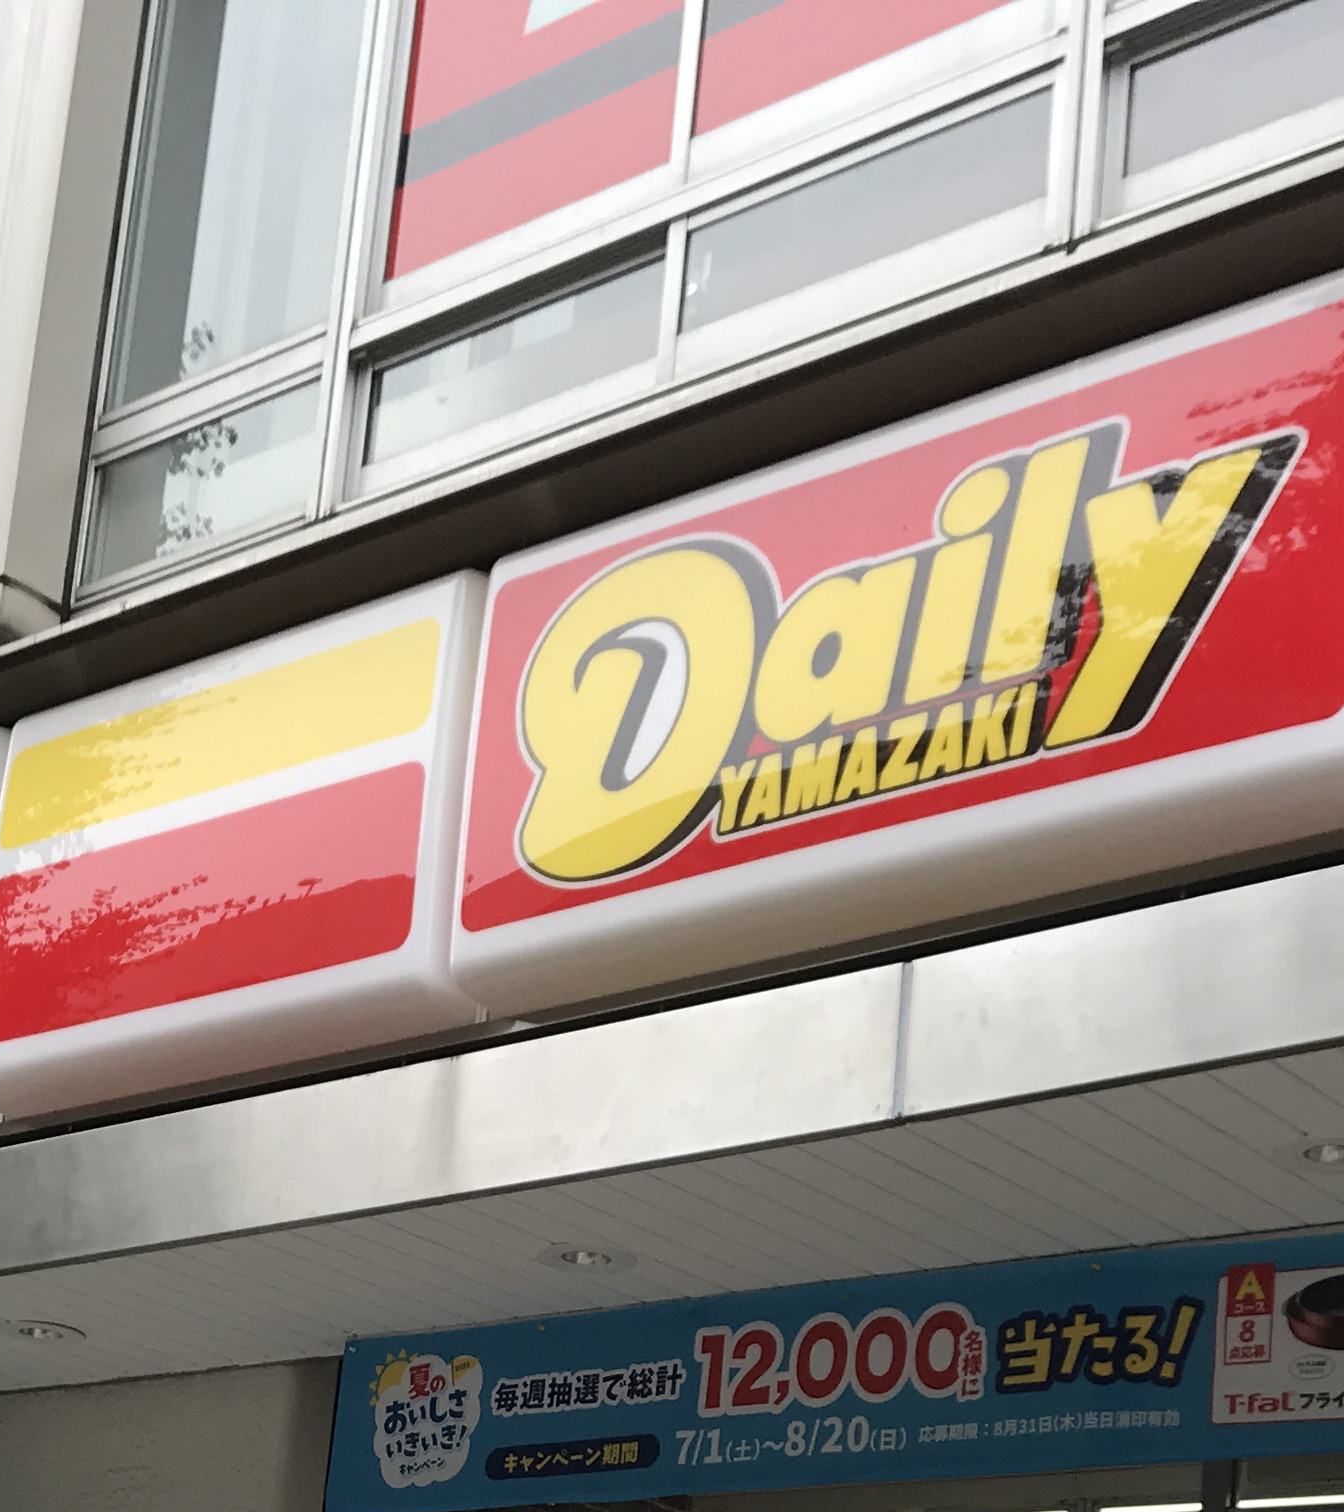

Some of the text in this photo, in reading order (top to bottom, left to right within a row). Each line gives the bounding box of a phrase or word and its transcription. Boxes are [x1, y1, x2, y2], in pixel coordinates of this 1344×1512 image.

[518, 425, 1301, 882] Daily
[717, 682, 1043, 835] YAMAZAKI
[1235, 1270, 1266, 1301] A
[1233, 1301, 1267, 1314] コース
[1002, 1303, 1201, 1387] 当たる!
[1239, 1320, 1256, 1343] 8
[700, 1308, 968, 1411] 12,000
[408, 1362, 447, 1400] 夏の
[494, 1363, 684, 1413] 毎週抽選で総計
[384, 1388, 468, 1435] おいしさ
[1224, 1391, 1296, 1415] T-fal
[385, 1424, 468, 1459] いきいき!
[503, 1440, 640, 1475] キャンペーン期間
[398, 1456, 447, 1476] キャンペーン
